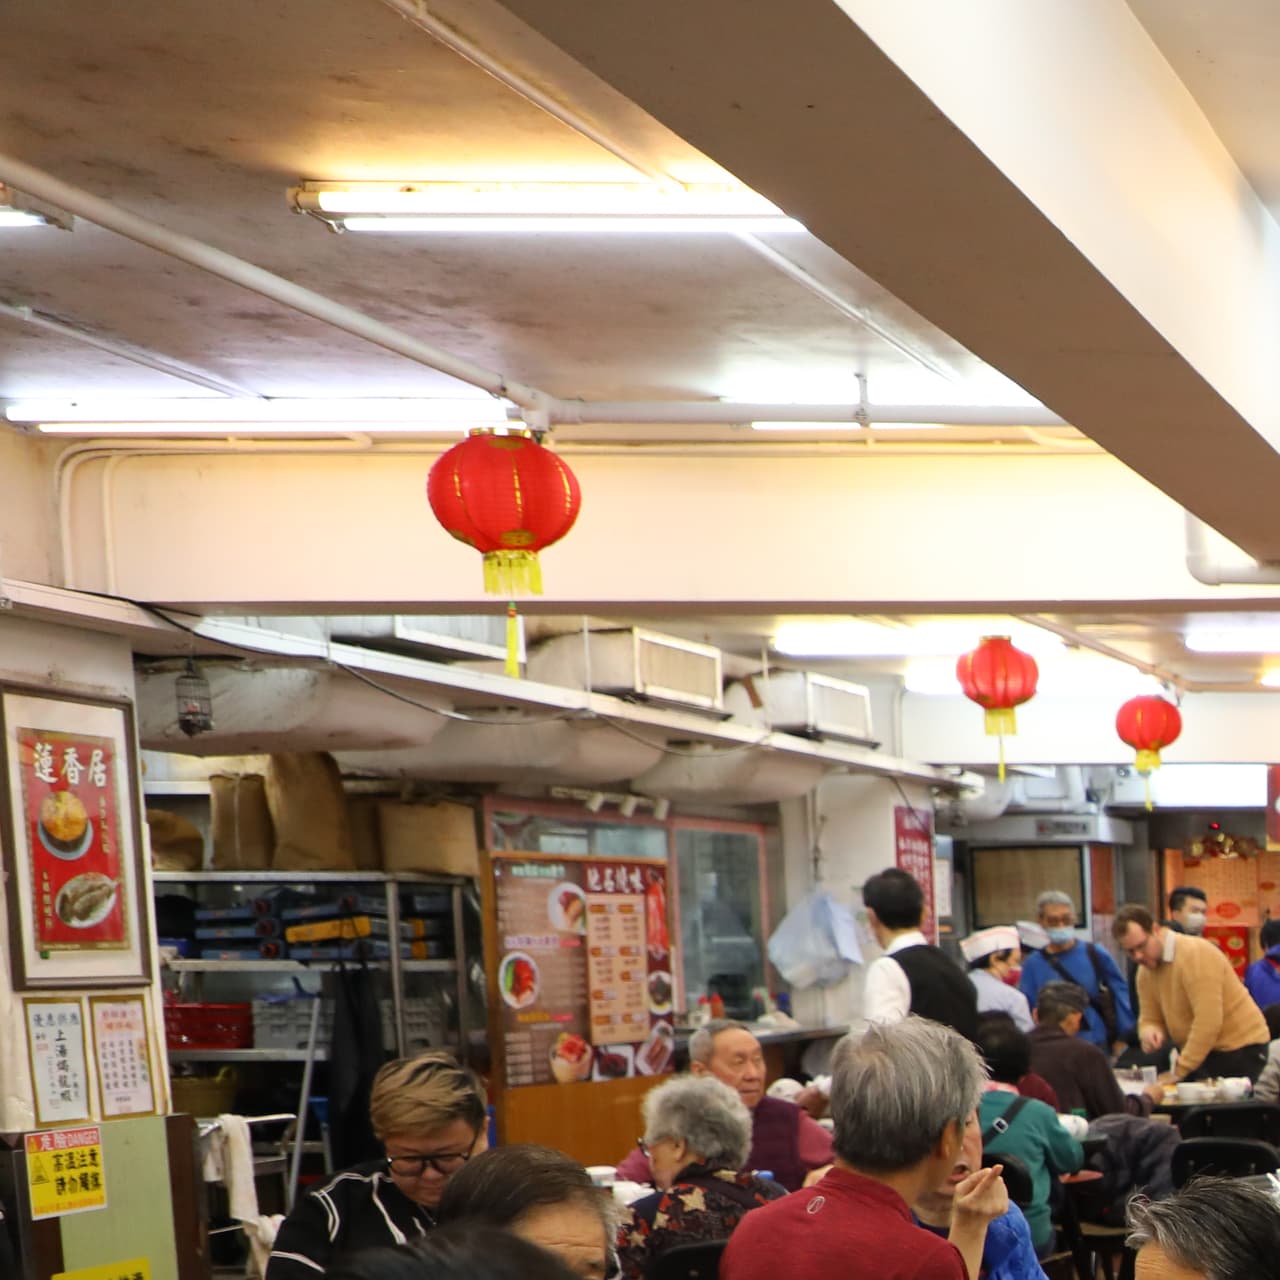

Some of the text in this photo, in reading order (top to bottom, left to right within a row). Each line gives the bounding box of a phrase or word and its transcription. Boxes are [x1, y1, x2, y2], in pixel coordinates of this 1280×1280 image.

[34, 743, 107, 787] 蓮香居
[68, 1129, 98, 1146] DANGER
